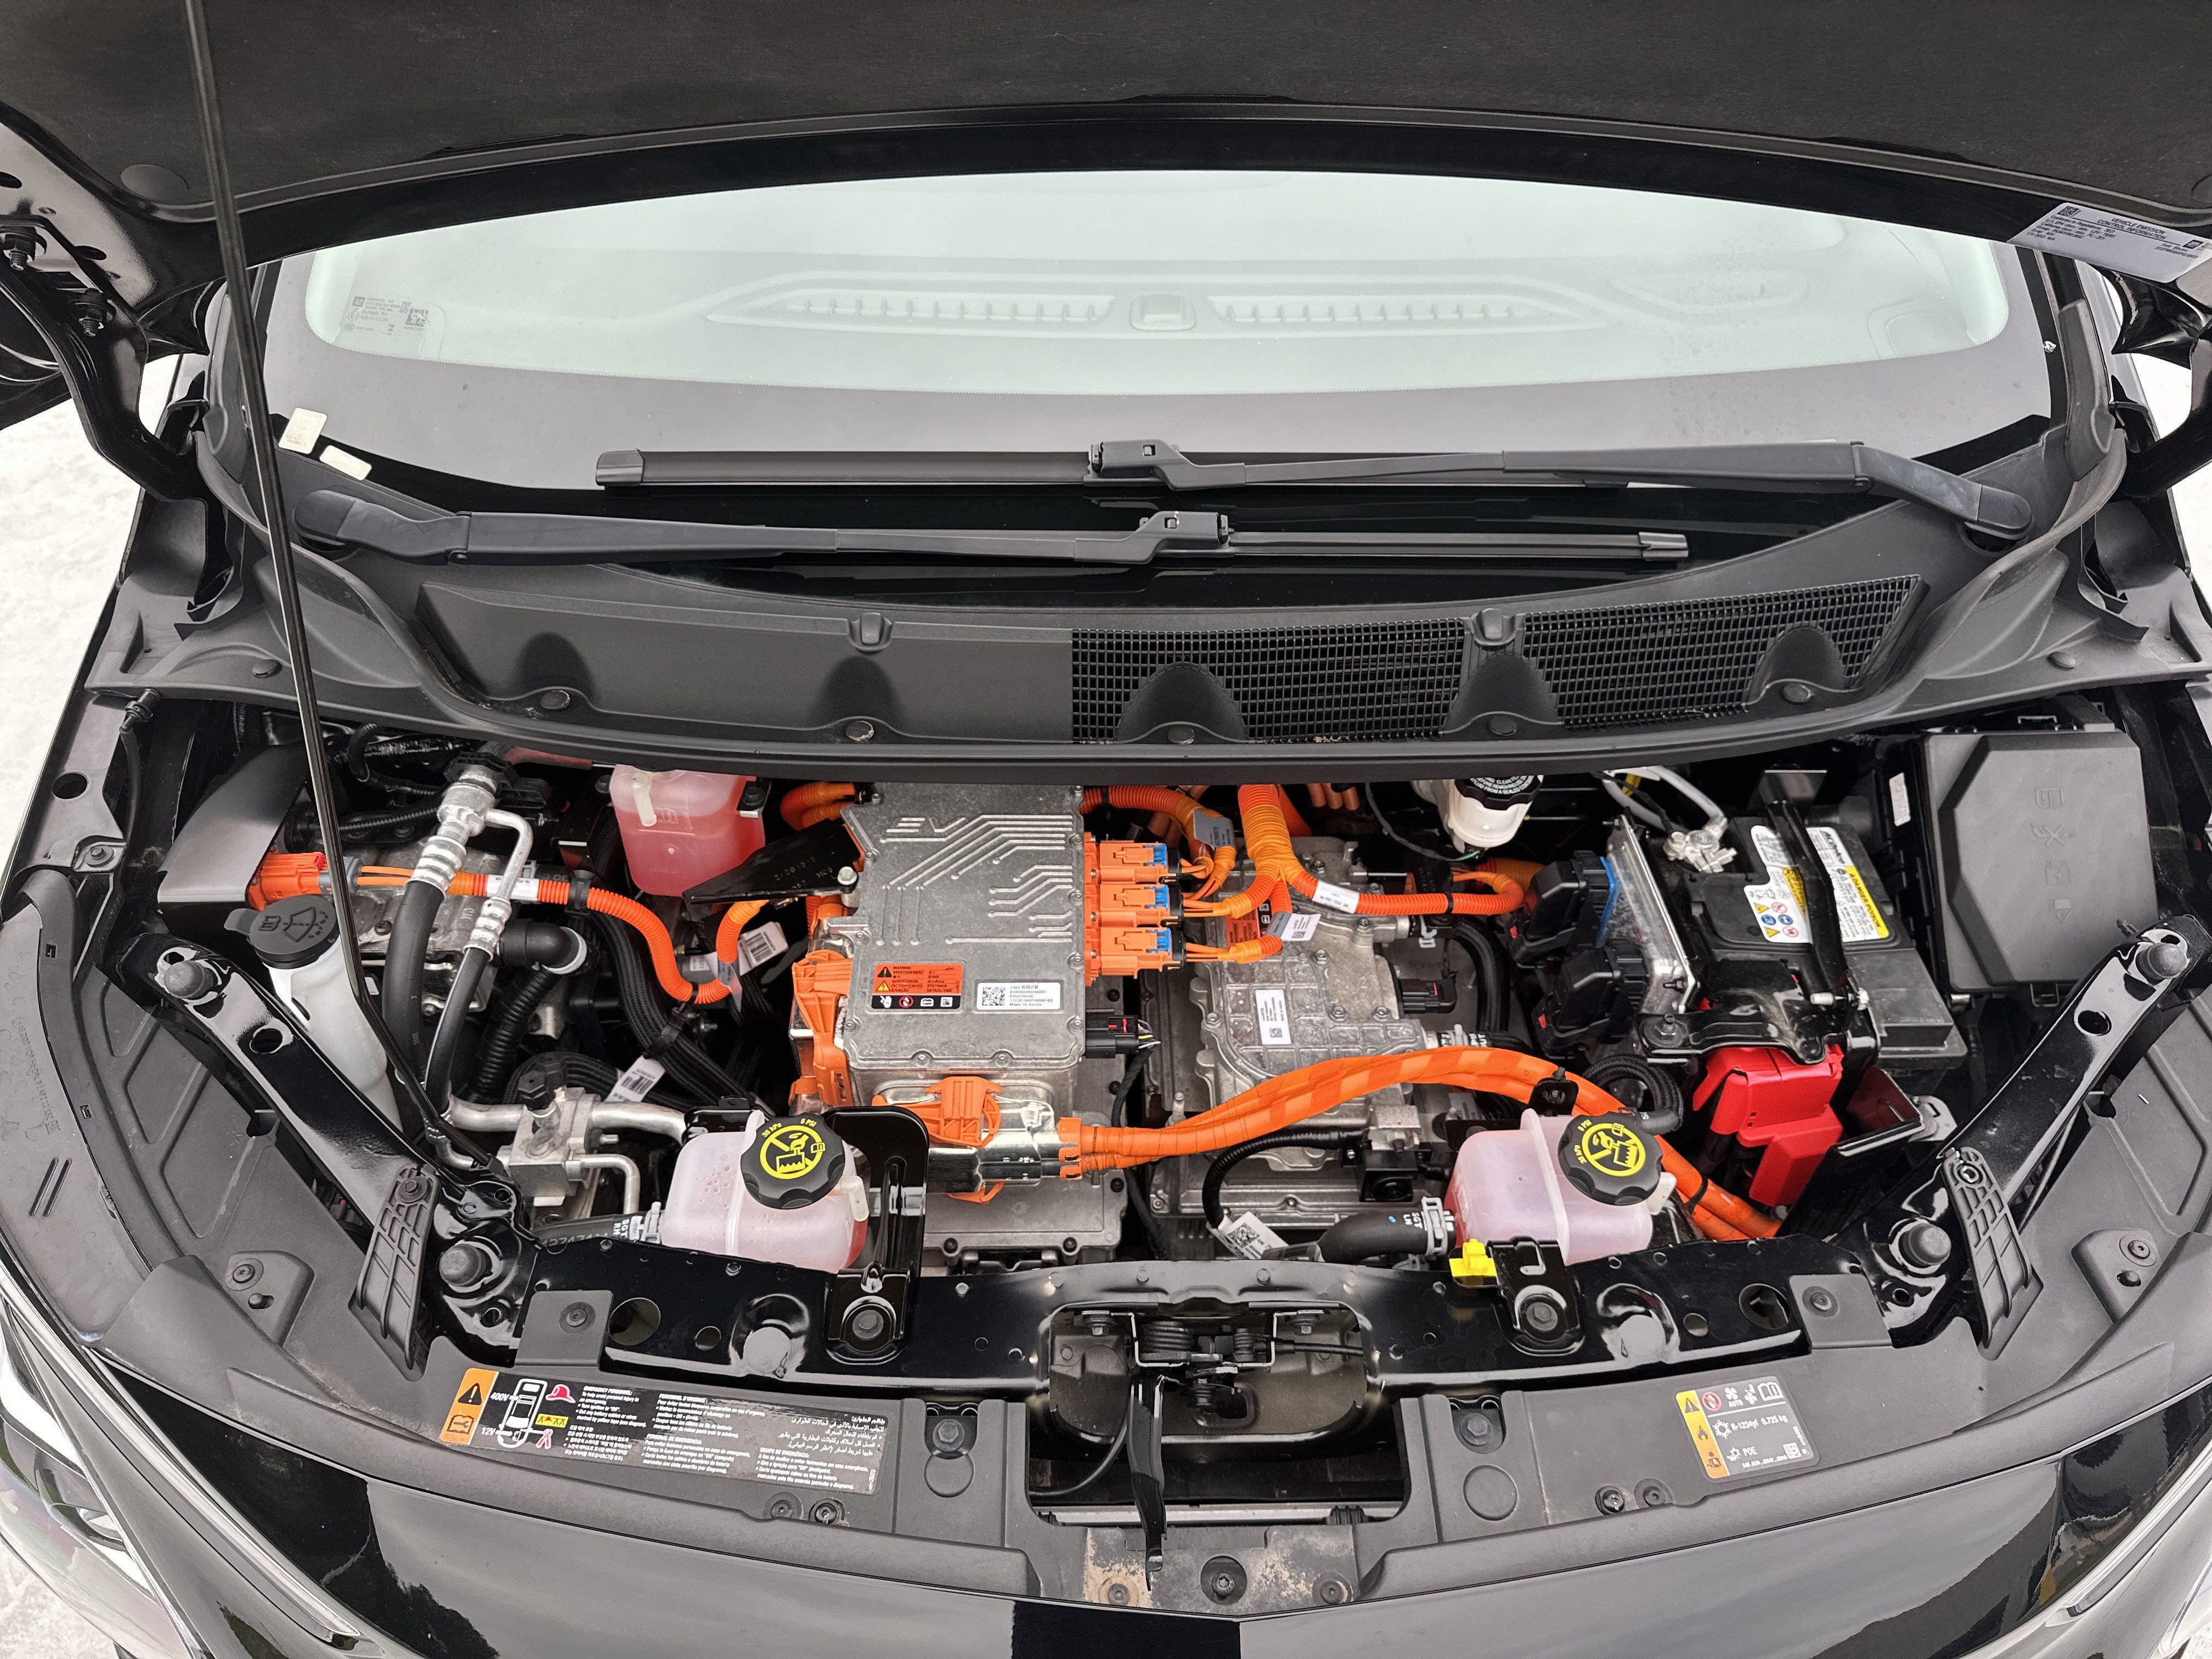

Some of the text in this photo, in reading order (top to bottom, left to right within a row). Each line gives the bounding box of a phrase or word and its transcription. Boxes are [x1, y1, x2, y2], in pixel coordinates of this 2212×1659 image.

[805, 1119, 818, 1127] PSI
[761, 1122, 782, 1138] 35 kPa
[1412, 1212, 1423, 1228] SGT
[490, 1392, 510, 1401] 400V
[1728, 1399, 1743, 1407] AUTO
[1731, 1414, 1789, 1431] R-1234yf 0.725 kg
[481, 1426, 496, 1436] 12V
[1742, 1446, 1758, 1457] POE
